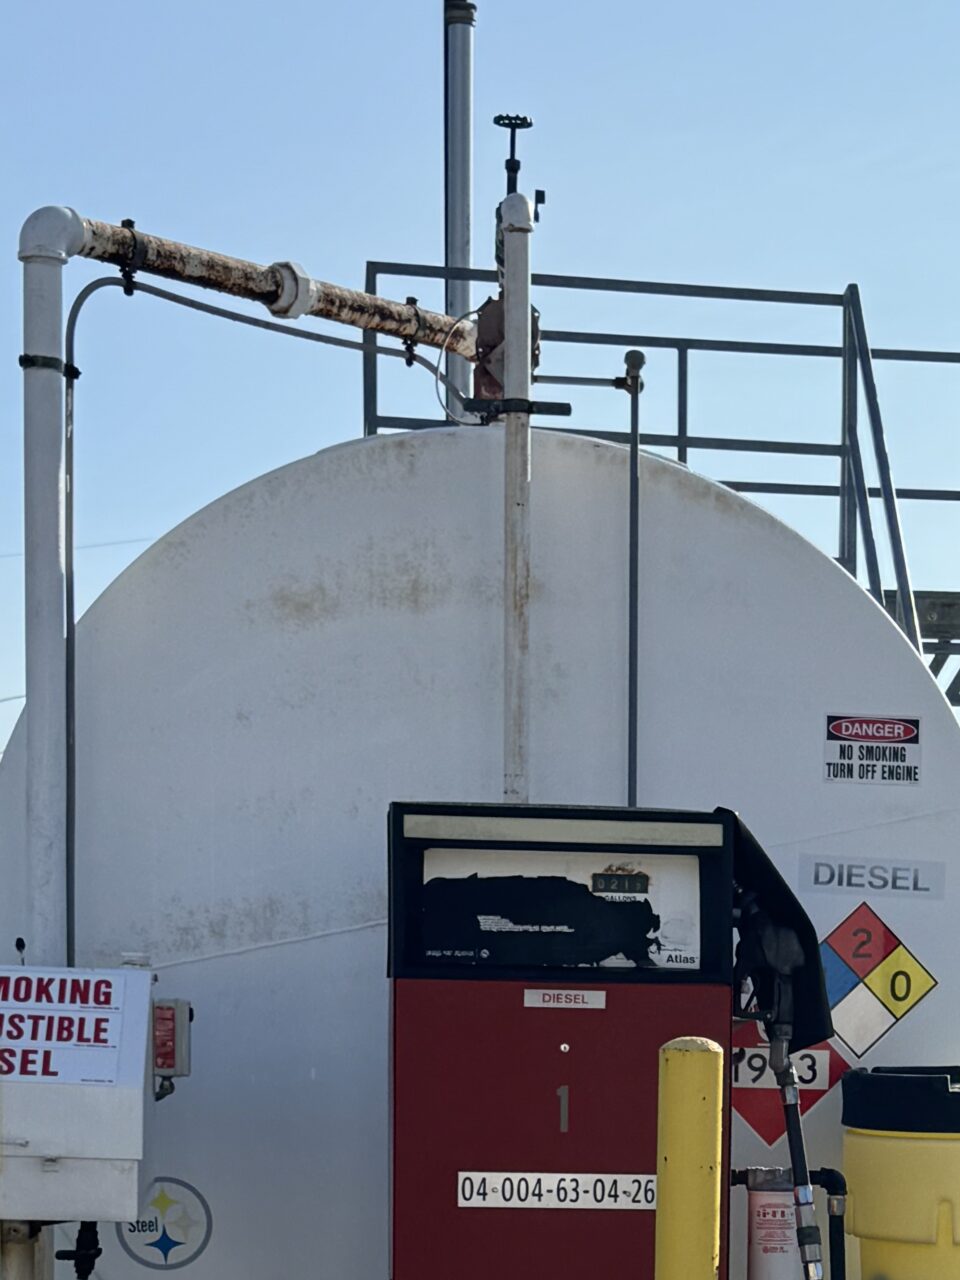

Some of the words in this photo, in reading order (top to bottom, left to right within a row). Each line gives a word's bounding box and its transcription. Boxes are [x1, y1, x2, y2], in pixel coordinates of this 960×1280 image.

[841, 722, 904, 738] DANGER
[839, 744, 853, 760] NO
[858, 745, 906, 762] SMOKING
[826, 763, 853, 778] TURN
[858, 764, 877, 780] OFF
[881, 765, 919, 781] ENGINE
[813, 862, 930, 892] DIESEL
[852, 928, 872, 958] 2
[666, 954, 696, 964] Atlas
[542, 993, 588, 1004] DIESEL
[890, 971, 911, 1002] 0
[0, 1014, 109, 1044] STIBLE
[734, 1053, 817, 1084] 193
[556, 1085, 569, 1133] 1
[461, 1177, 655, 1203] 04004-63-04-26
[128, 1216, 159, 1233] Steel
